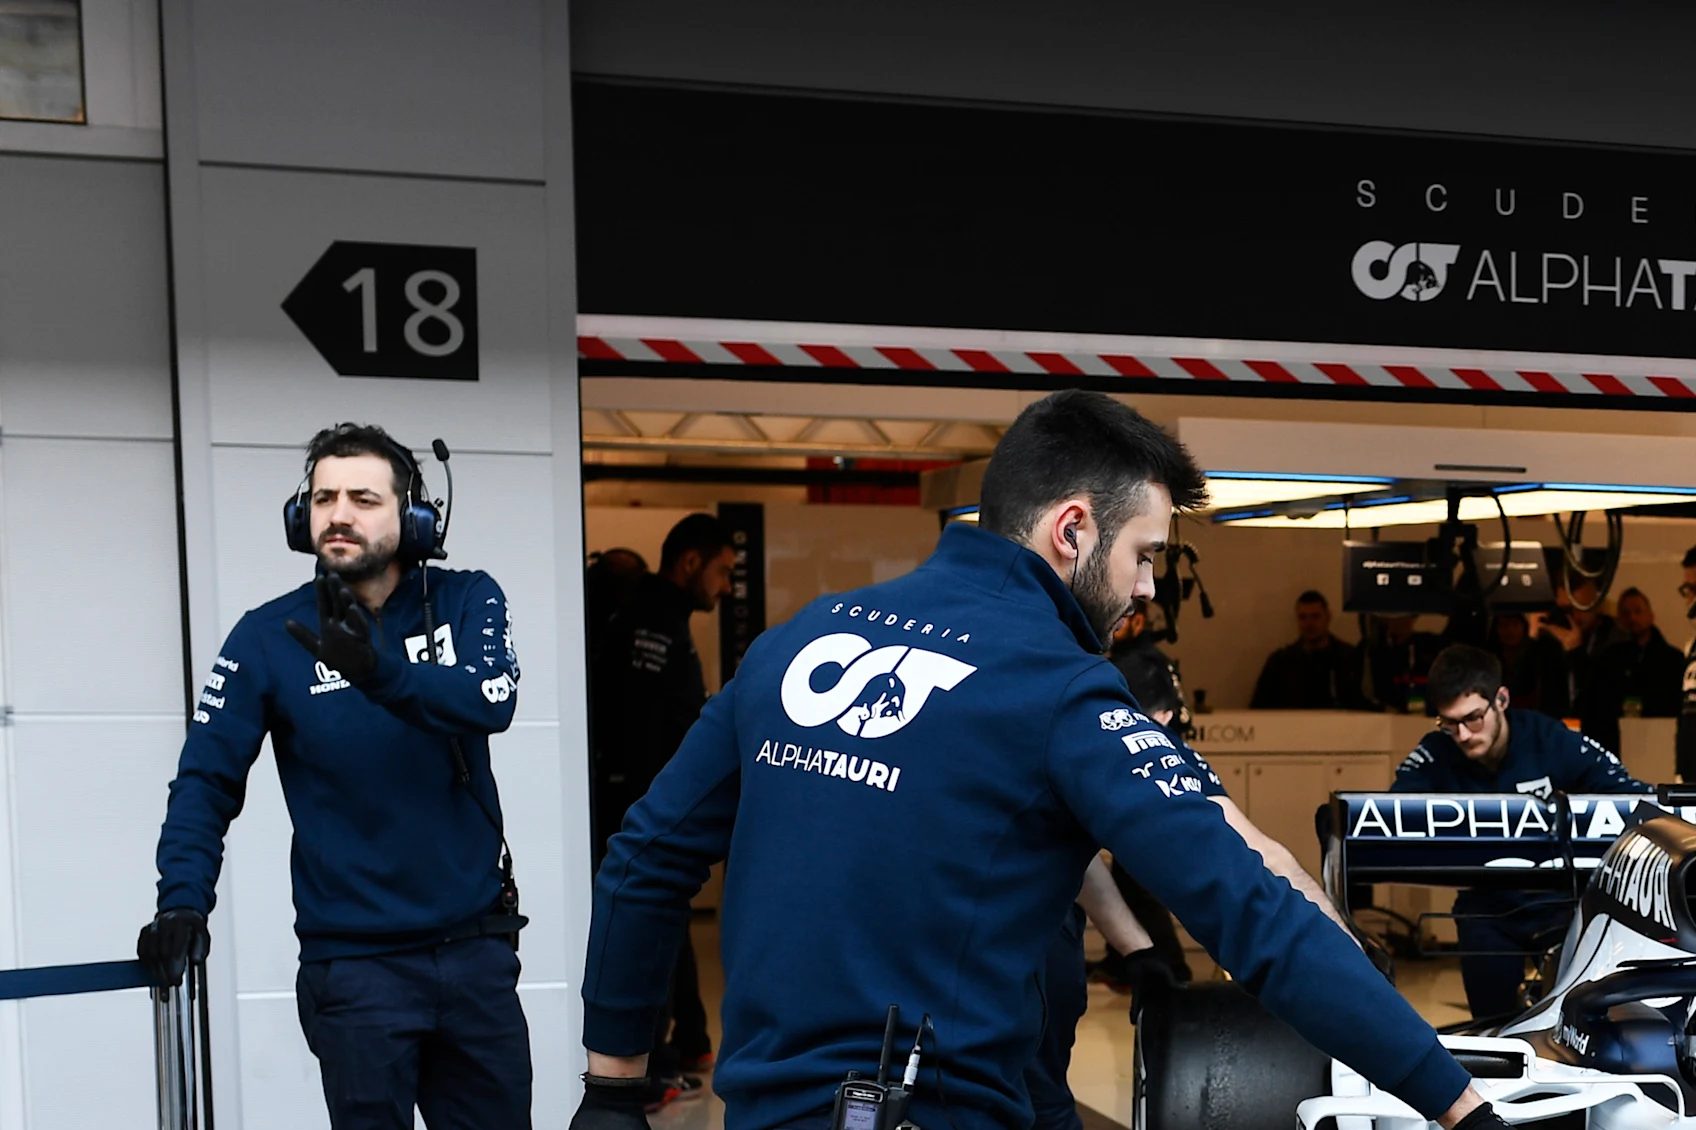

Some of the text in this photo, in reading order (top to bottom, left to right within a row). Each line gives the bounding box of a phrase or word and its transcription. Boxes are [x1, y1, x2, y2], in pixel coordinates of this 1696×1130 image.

[341, 267, 465, 357] 18
[831, 602, 971, 643] SCUDERIA
[755, 739, 901, 792] ALPHATAURI
